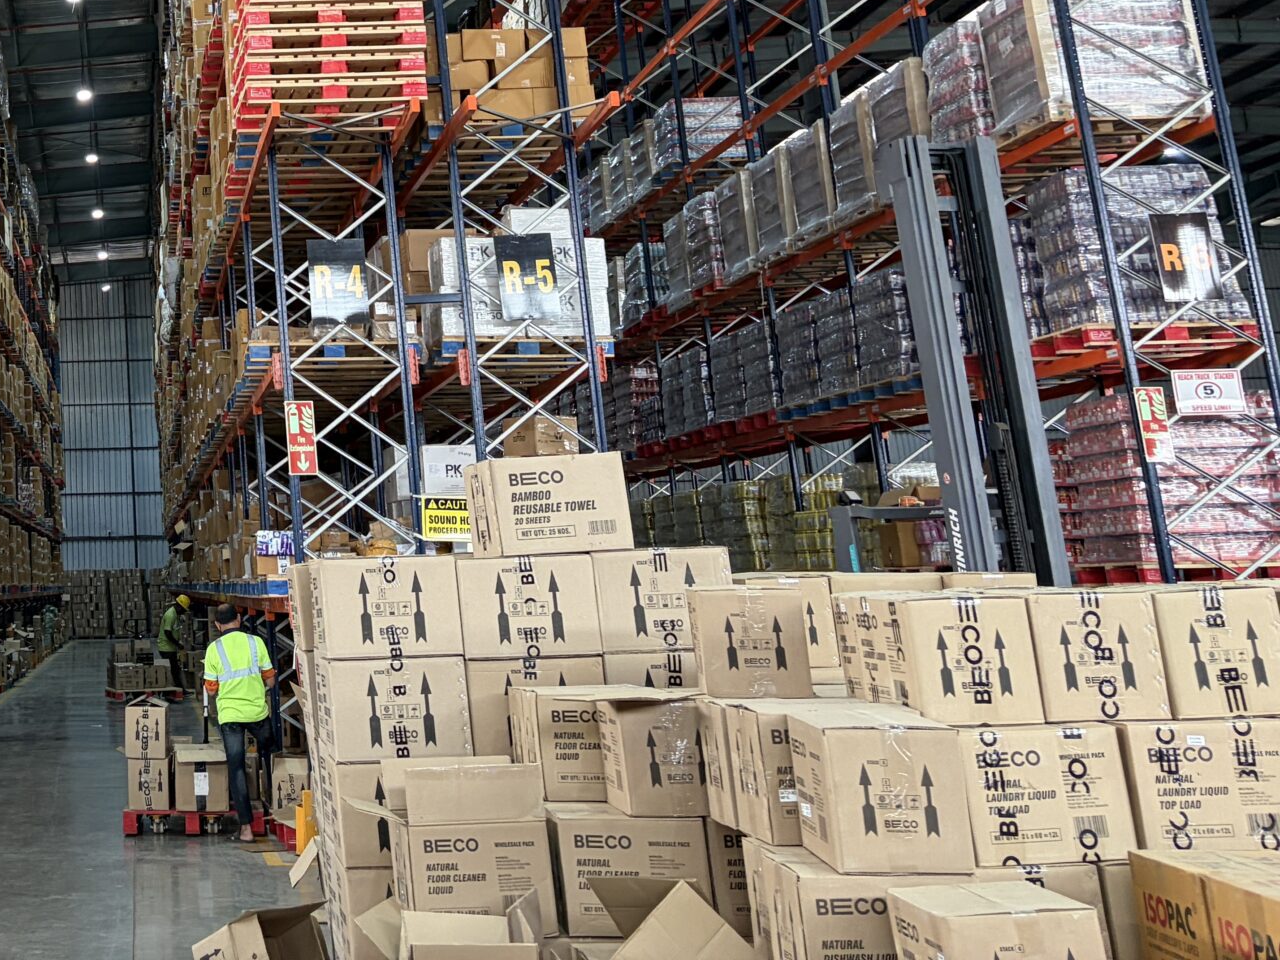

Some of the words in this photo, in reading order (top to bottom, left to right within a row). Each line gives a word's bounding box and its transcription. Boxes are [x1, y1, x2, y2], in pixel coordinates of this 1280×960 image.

[314, 264, 365, 299] R-4
[502, 259, 554, 294] R-5
[1203, 385, 1214, 396] 5
[1191, 404, 1212, 412] SPEED
[297, 436, 306, 444] Fire
[445, 464, 462, 475] PK
[508, 470, 564, 487] BECO
[511, 490, 551, 503] BAMBOO
[438, 500, 467, 509] CAUT
[513, 502, 562, 516] REUSABLE
[564, 499, 597, 512] TOWEL
[428, 515, 457, 525] SOUND
[514, 517, 523, 525] 20
[525, 515, 551, 525] SHEETS
[428, 526, 458, 535] PROCEED
[521, 529, 533, 537] NET
[744, 657, 771, 665] BECO
[553, 732, 585, 740] NATURAL
[555, 742, 577, 750] FLOOR
[579, 741, 602, 750] CLEAN
[555, 752, 580, 761] LIQUID
[986, 792, 1025, 803] LAUNDRY
[1028, 790, 1056, 801] LIQUID
[1157, 788, 1198, 797] LAUNDRY
[1200, 786, 1229, 796] LIQUID
[1160, 801, 1177, 810] TOP
[1180, 800, 1201, 809] LOAD
[988, 806, 1005, 816] TOP
[884, 819, 918, 829] BECO
[423, 838, 479, 854] BECO
[574, 834, 632, 849] BECO
[426, 862, 460, 872] NATURAL
[576, 858, 611, 867] NATURAL
[427, 875, 451, 883] FLOOR
[453, 873, 487, 883] CLEANER
[428, 885, 454, 895] LIQUID
[815, 898, 887, 916] BECO
[1143, 890, 1196, 940] ISOPAC
[1218, 916, 1280, 960] ISOPA
[822, 939, 864, 950] NATURAL
